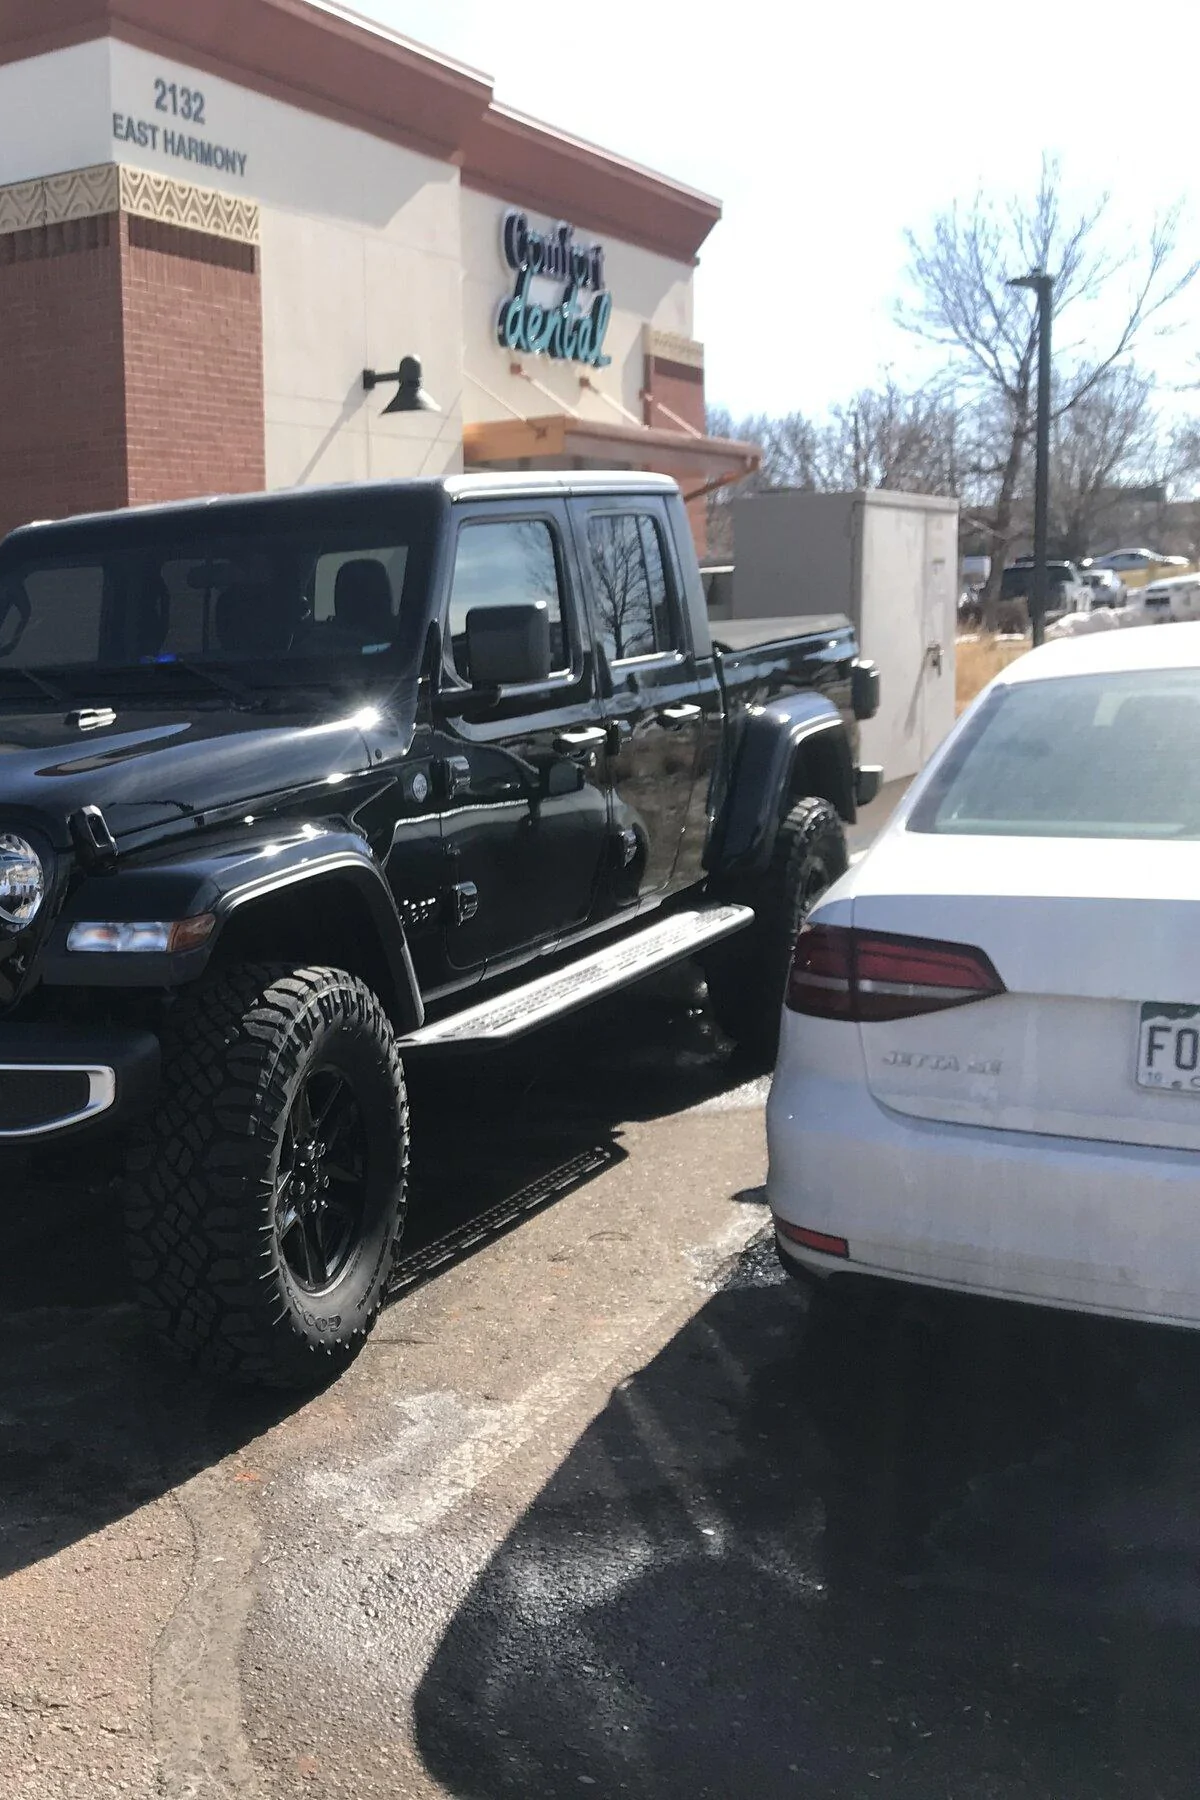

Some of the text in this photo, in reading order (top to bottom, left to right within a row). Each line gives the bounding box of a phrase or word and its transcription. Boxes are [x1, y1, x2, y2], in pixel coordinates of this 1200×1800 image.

[154, 78, 206, 125] 2132
[112, 112, 248, 177] EAST HARMONY
[497, 265, 614, 368] dental
